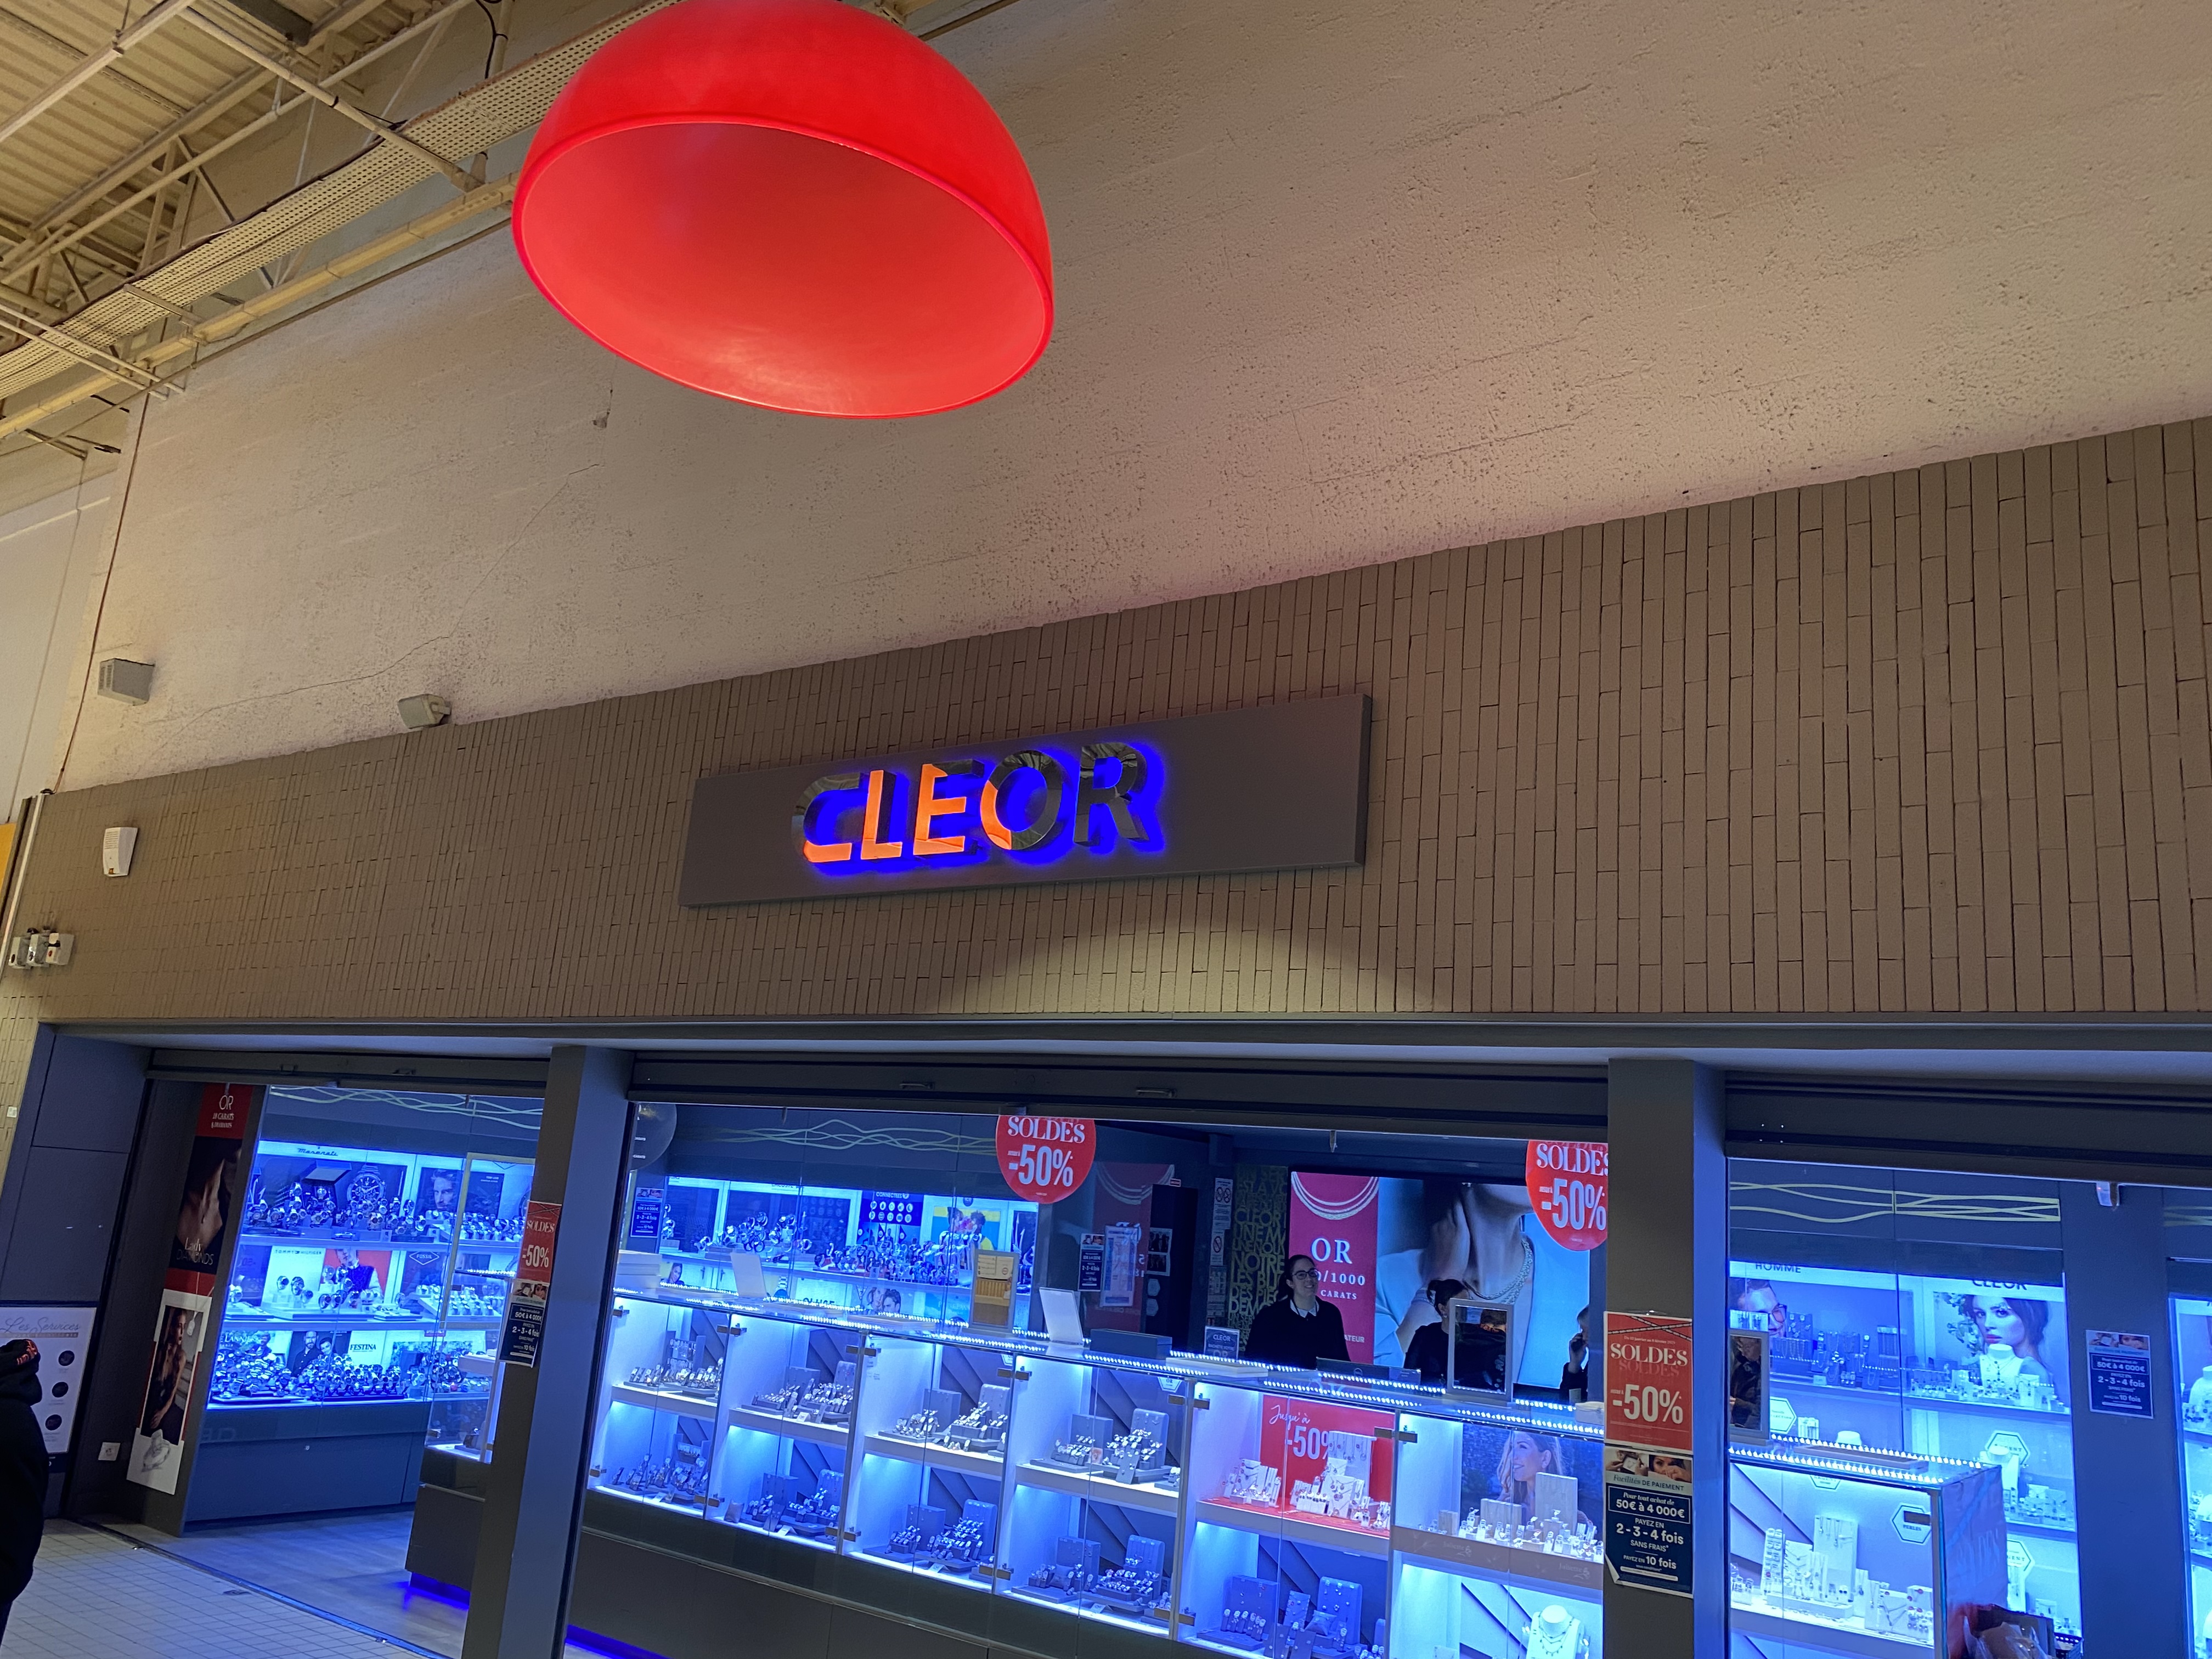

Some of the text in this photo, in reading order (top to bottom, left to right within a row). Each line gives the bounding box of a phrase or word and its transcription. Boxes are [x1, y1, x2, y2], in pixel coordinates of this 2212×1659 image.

[791, 742, 1149, 863] CLEOR
[219, 1095, 234, 1110] OR
[1007, 1116, 1085, 1143] SOLDES
[527, 1220, 555, 1233] SOLDES
[1311, 1238, 1353, 1264] OR
[1321, 1290, 1357, 1300] CARATS
[29, 1317, 80, 1333] Services
[1213, 1334, 1231, 1342] CLEOR
[1610, 1342, 1688, 1367] SOLDES
[2129, 1379, 2145, 1388] fois
[1651, 1482, 1684, 1491] PAIEMENT
[1650, 1497, 1667, 1505] achat
[1616, 1499, 1685, 1519] 50€ à 4 000€
[1635, 1517, 1655, 1527] PAYEZ
[1616, 1523, 1624, 1534] 2
[1633, 1526, 1641, 1537] 3
[1650, 1530, 1659, 1540] 4
[1661, 1530, 1684, 1545] fois
[1630, 1539, 1647, 1548] SANS
[1645, 1556, 1657, 1566] 10
[1658, 1558, 1677, 1570] fois
